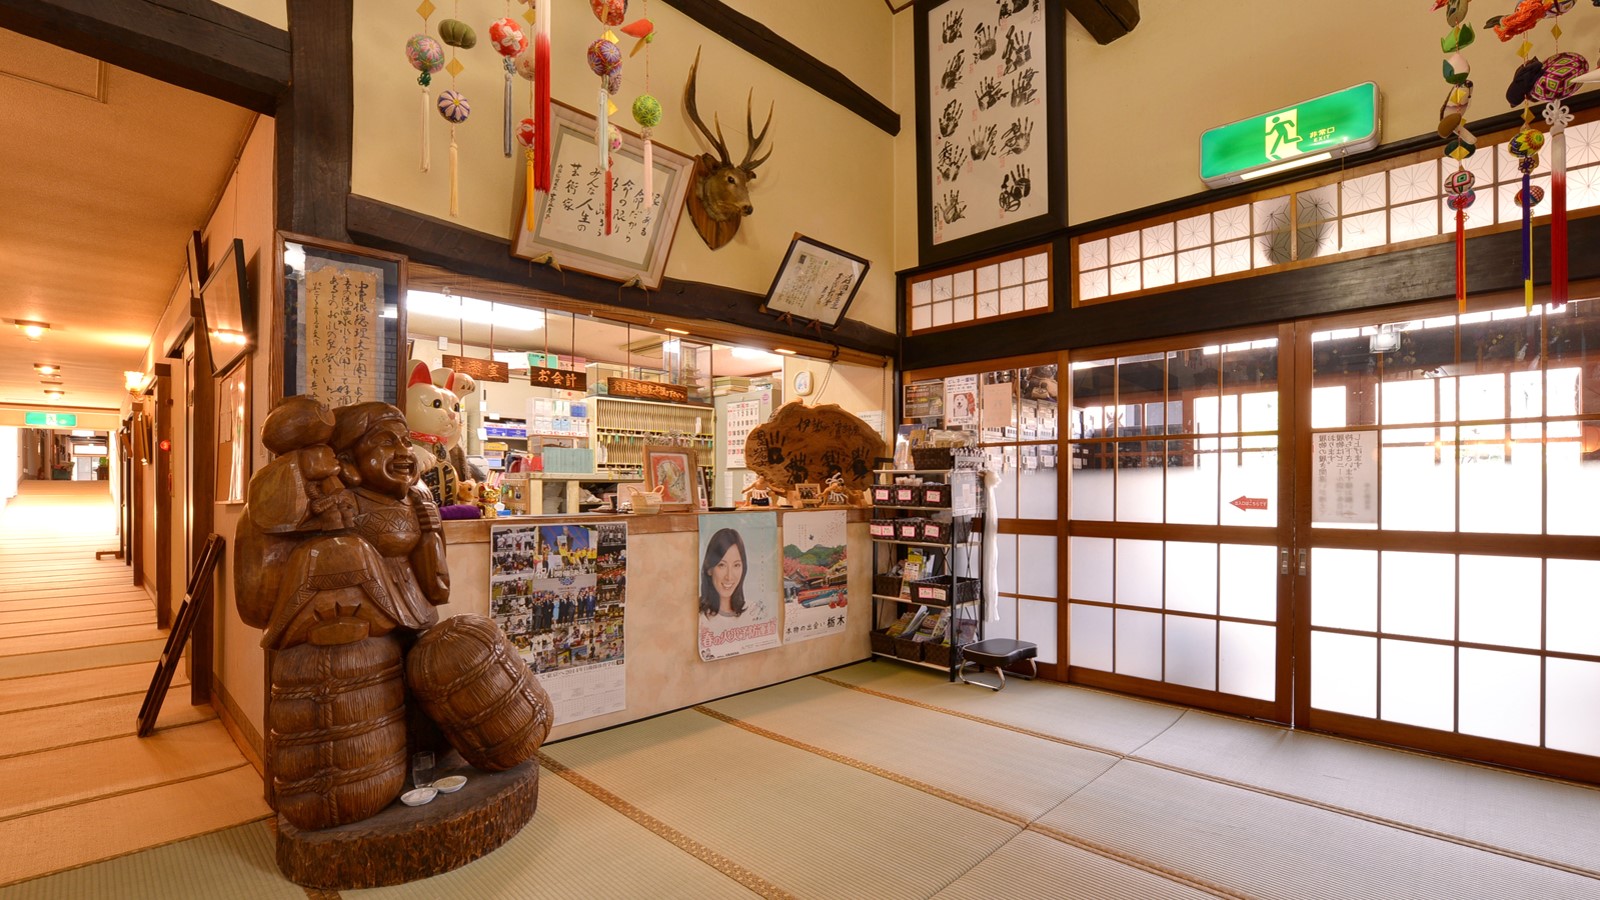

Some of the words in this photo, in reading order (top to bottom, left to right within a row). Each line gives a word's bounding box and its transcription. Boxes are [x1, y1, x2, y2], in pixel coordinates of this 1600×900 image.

[1310, 126, 1335, 138] 非常口
[562, 163, 582, 211] 芸術家
[538, 369, 577, 387] お会計
[827, 615, 845, 628] 栃木
